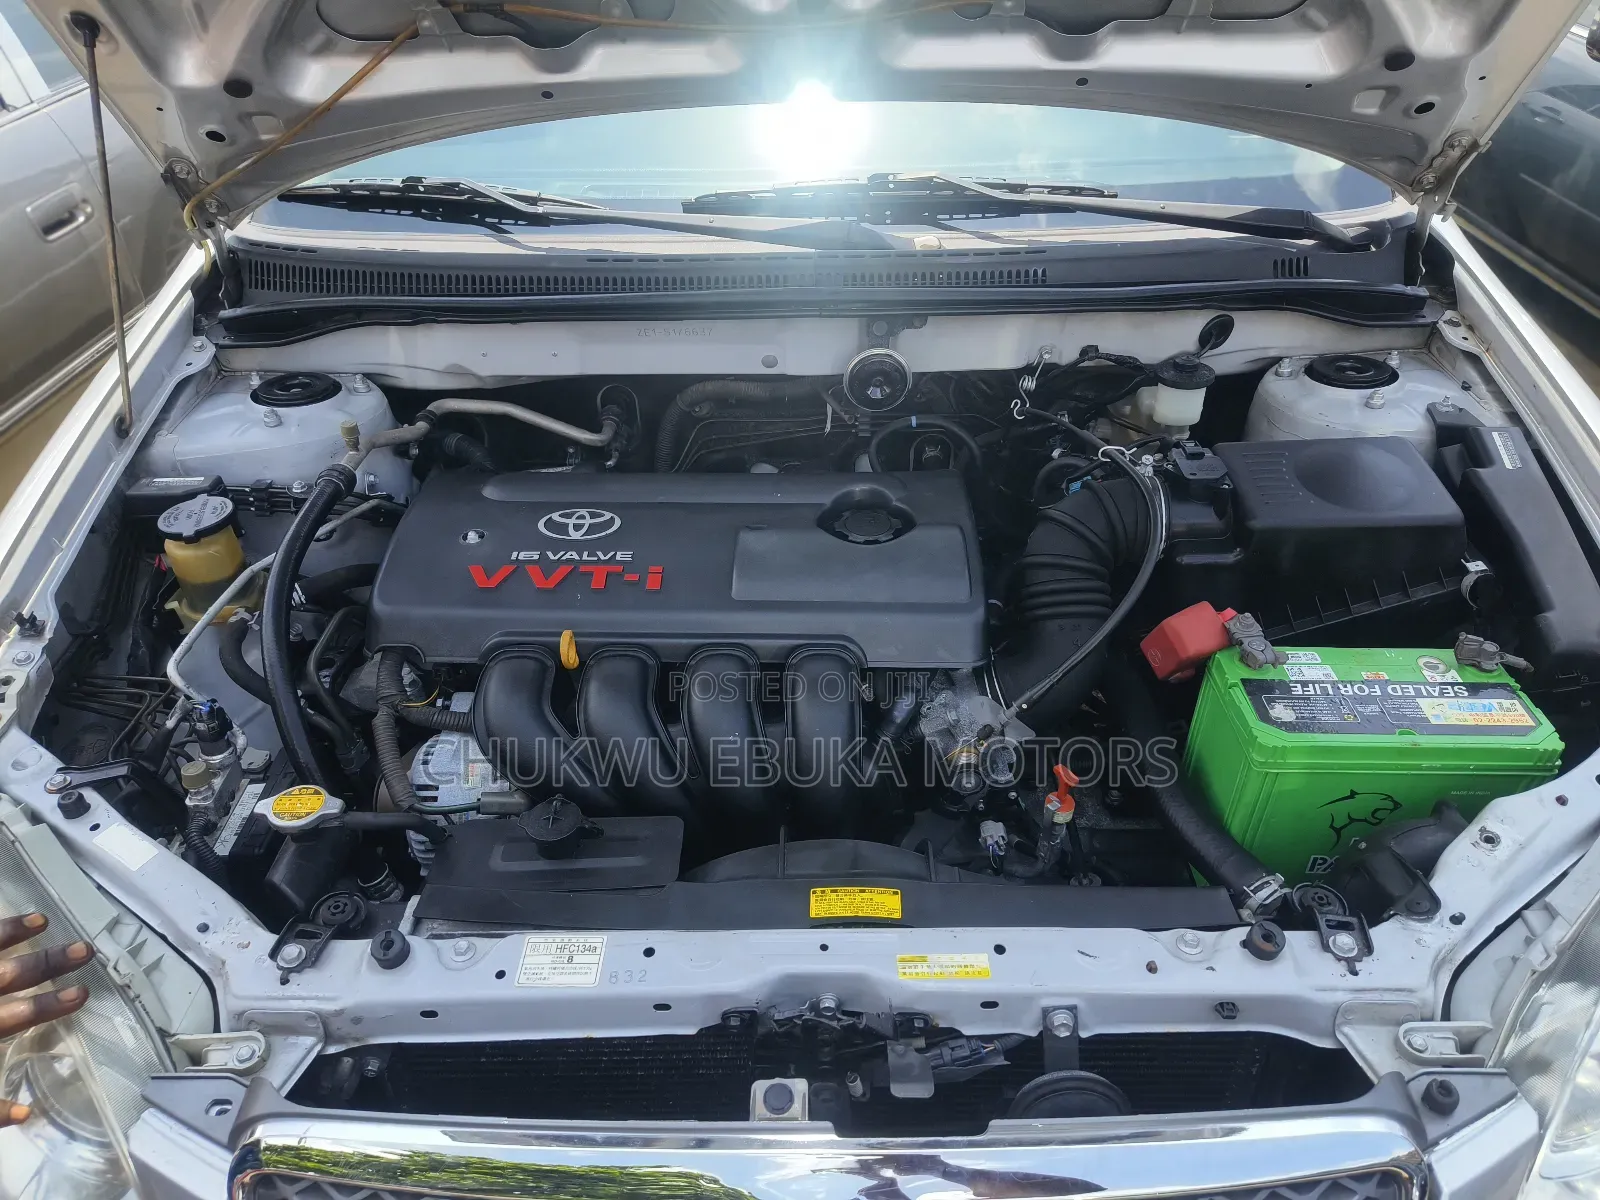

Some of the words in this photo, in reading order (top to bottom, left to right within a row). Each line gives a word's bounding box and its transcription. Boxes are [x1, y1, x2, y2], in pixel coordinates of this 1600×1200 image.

[510, 551, 541, 561] 16
[546, 551, 634, 561] VALVE
[468, 565, 664, 590] VVT-i
[1289, 683, 1334, 695] LIFE
[1338, 683, 1381, 696] FOR
[1387, 684, 1469, 697] SEALED
[555, 943, 598, 954] HFC134a
[566, 955, 574, 963] 8
